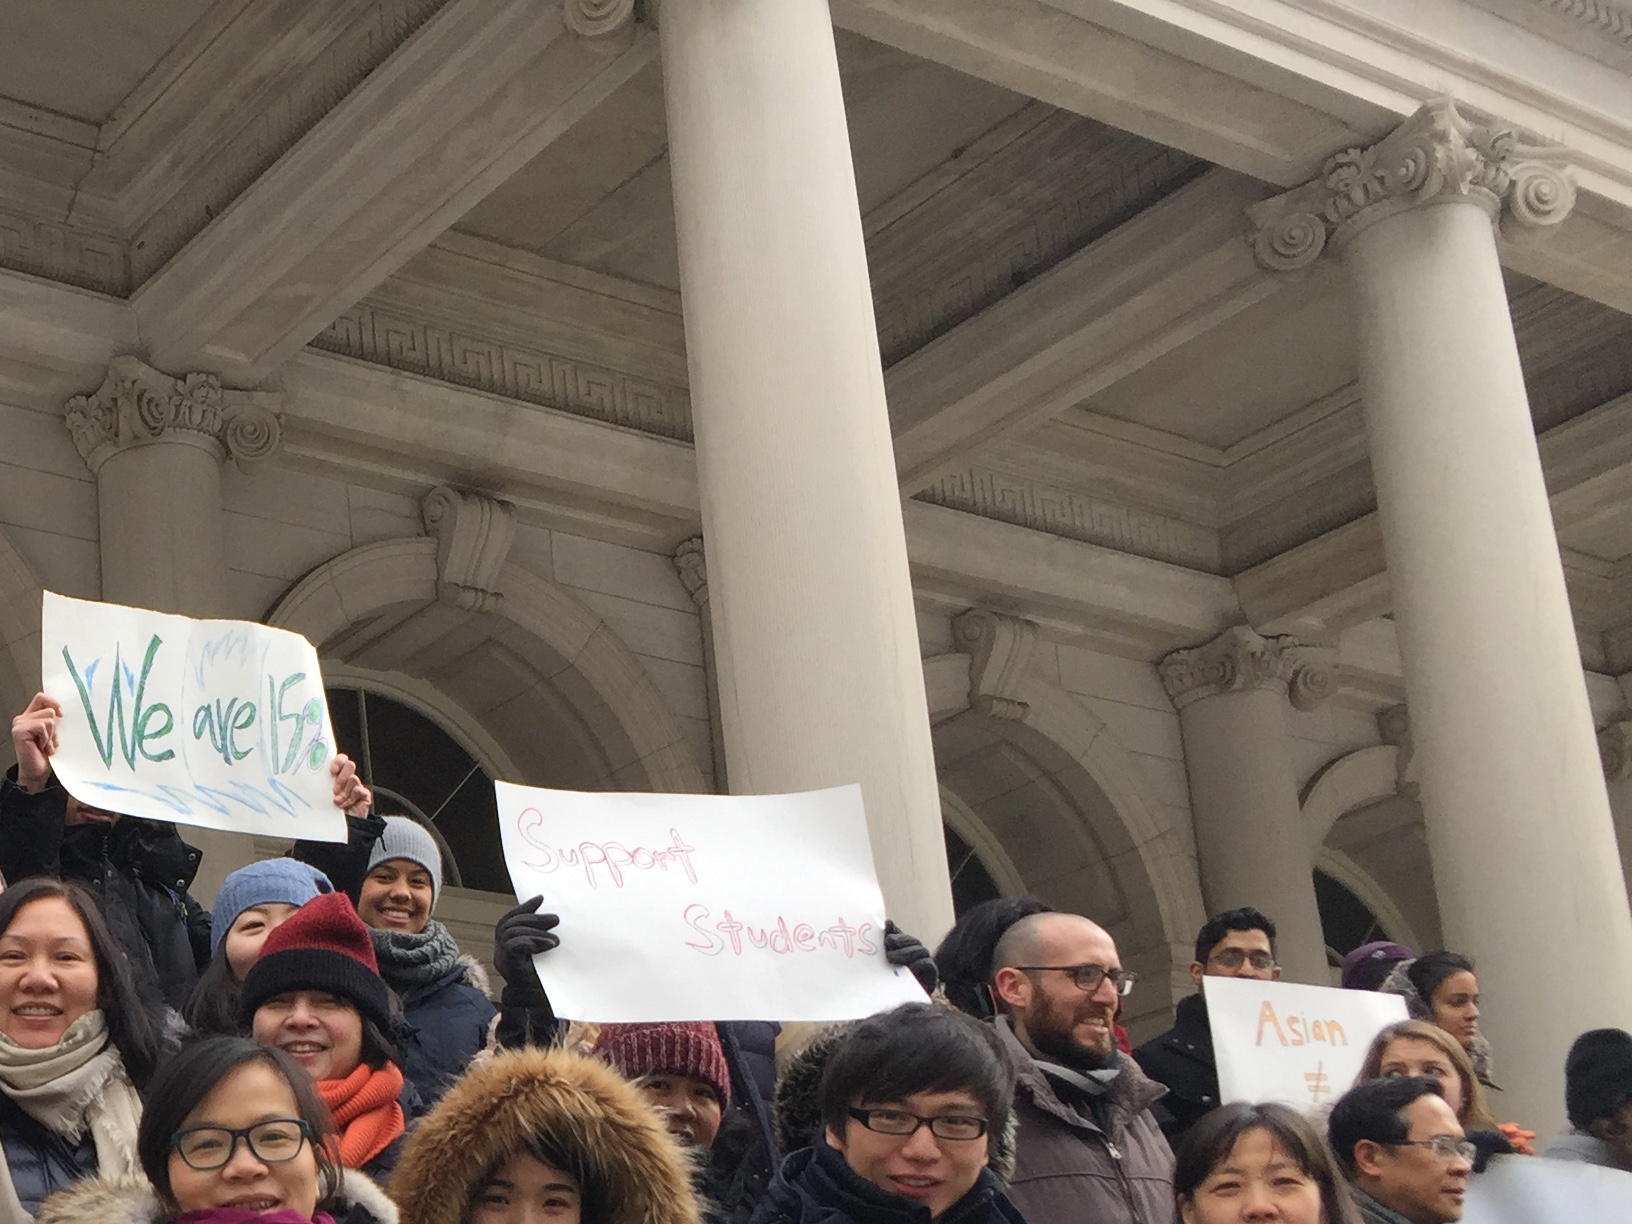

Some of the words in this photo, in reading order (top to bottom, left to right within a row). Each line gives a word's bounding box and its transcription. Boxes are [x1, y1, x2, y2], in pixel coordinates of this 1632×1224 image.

[61, 632, 176, 773] We
[192, 696, 257, 767] are
[267, 671, 329, 776] 15%
[516, 806, 698, 890] Support
[682, 902, 878, 958] Students
[1254, 999, 1349, 1048] Asian
